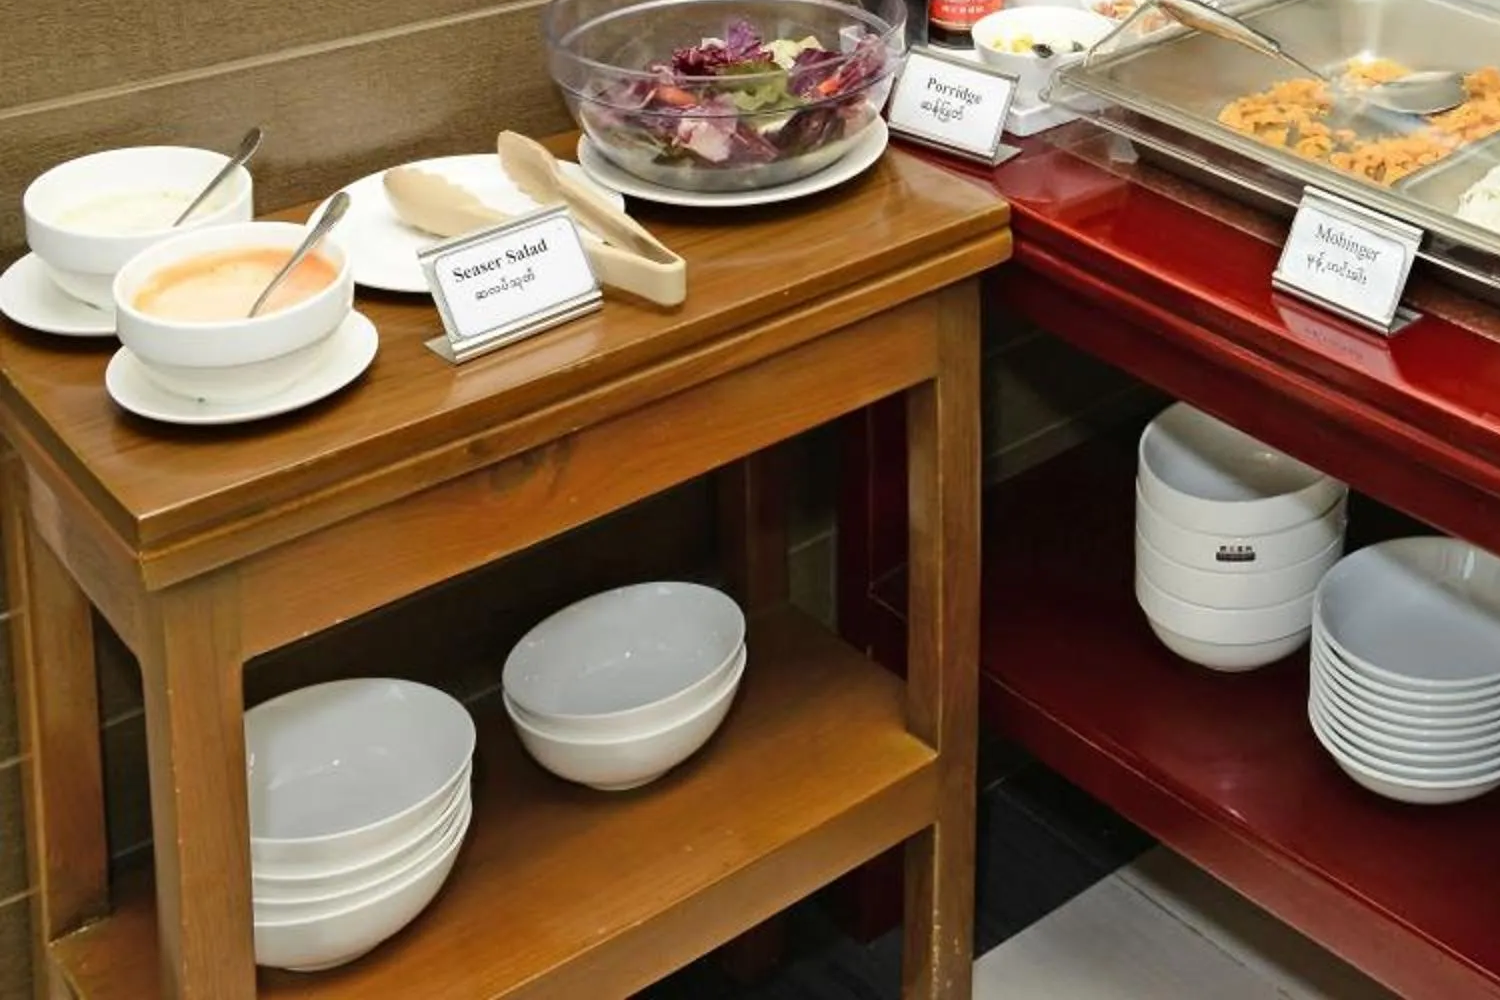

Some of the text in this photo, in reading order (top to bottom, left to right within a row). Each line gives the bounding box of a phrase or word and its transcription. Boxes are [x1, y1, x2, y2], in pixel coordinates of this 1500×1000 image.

[927, 76, 982, 105] Porridge
[452, 238, 549, 283] Seaser Salad
[1314, 223, 1381, 263] Mohinger
